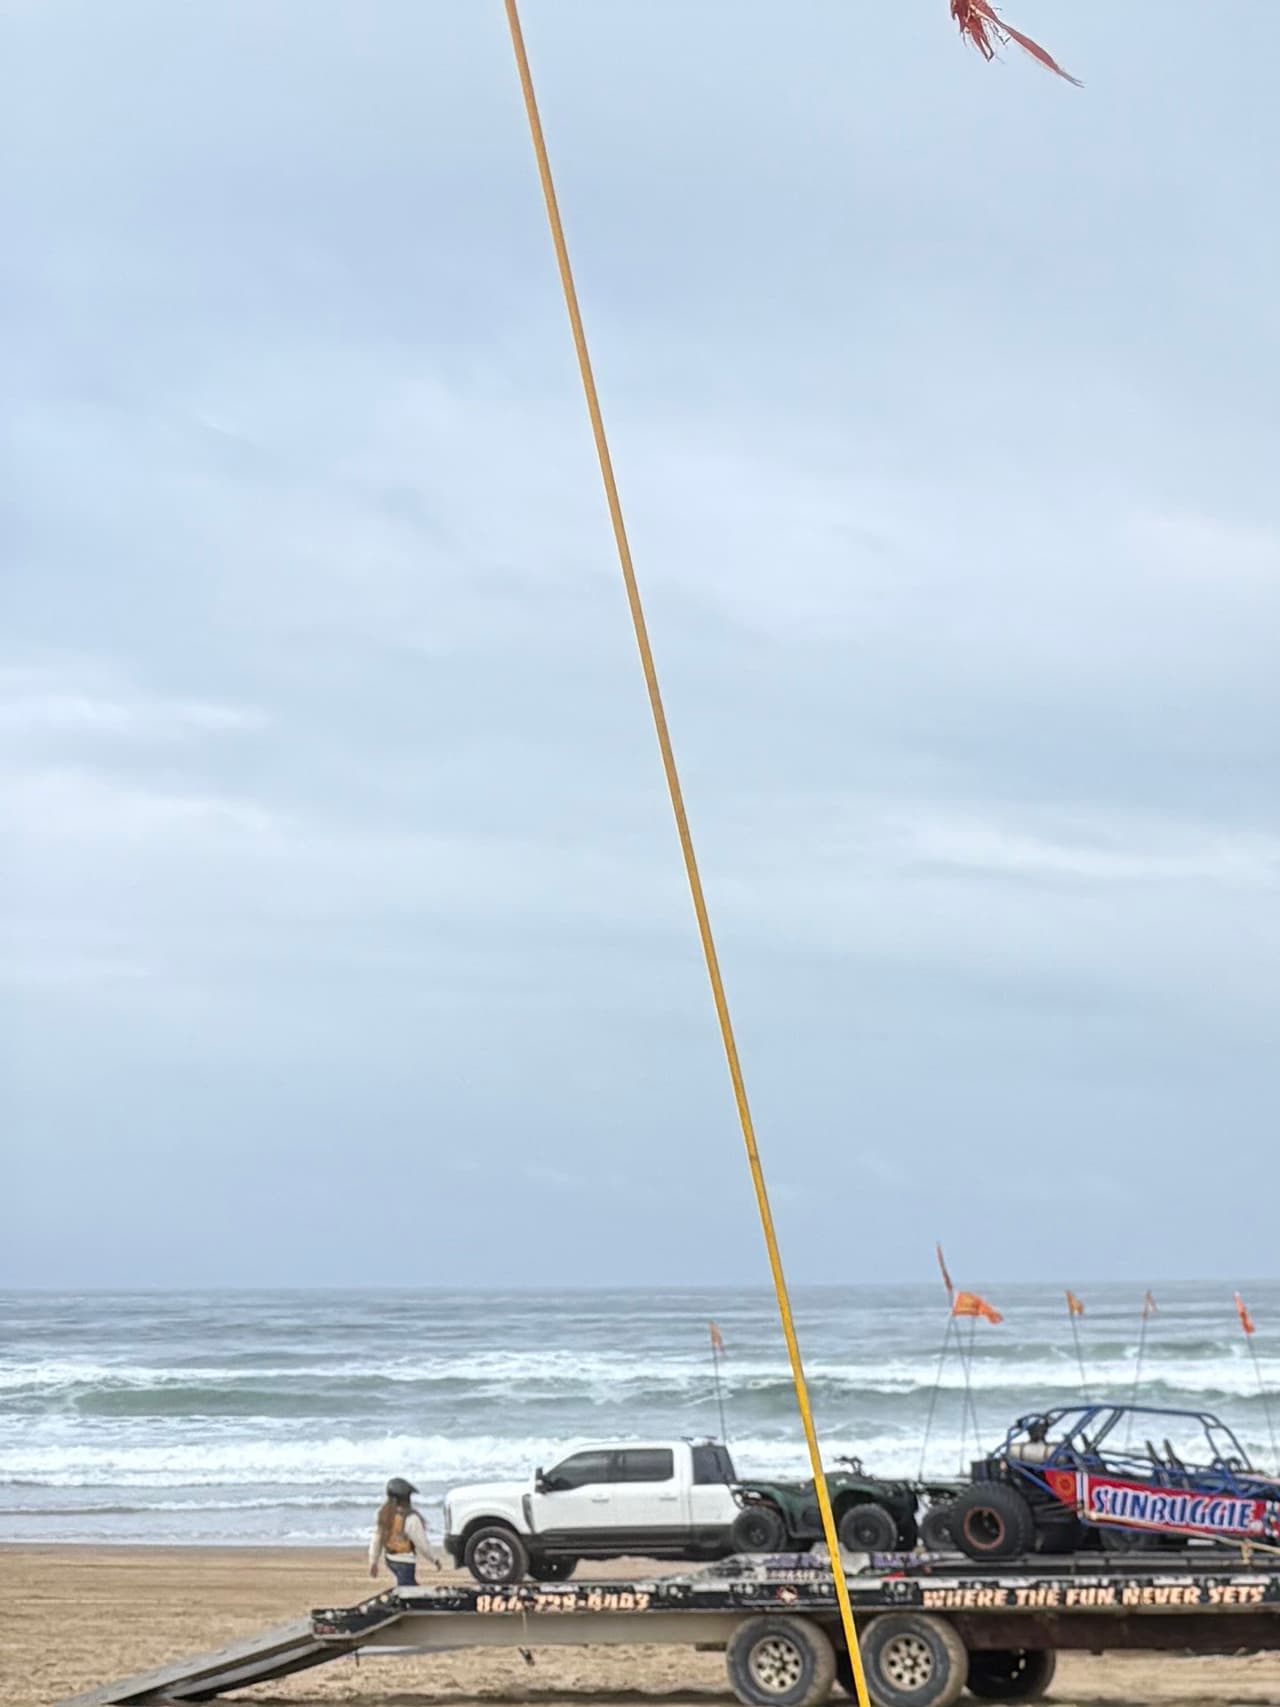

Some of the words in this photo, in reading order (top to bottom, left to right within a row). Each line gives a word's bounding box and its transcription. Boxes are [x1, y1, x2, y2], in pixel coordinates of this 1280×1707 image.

[1093, 1486, 1253, 1530] SUNBUGGIE
[922, 1588, 1008, 1608] WHERE
[1015, 1587, 1059, 1607] THE
[1066, 1587, 1115, 1606] FUN
[1123, 1586, 1201, 1606] NEVER
[1208, 1585, 1266, 1604] SETS
